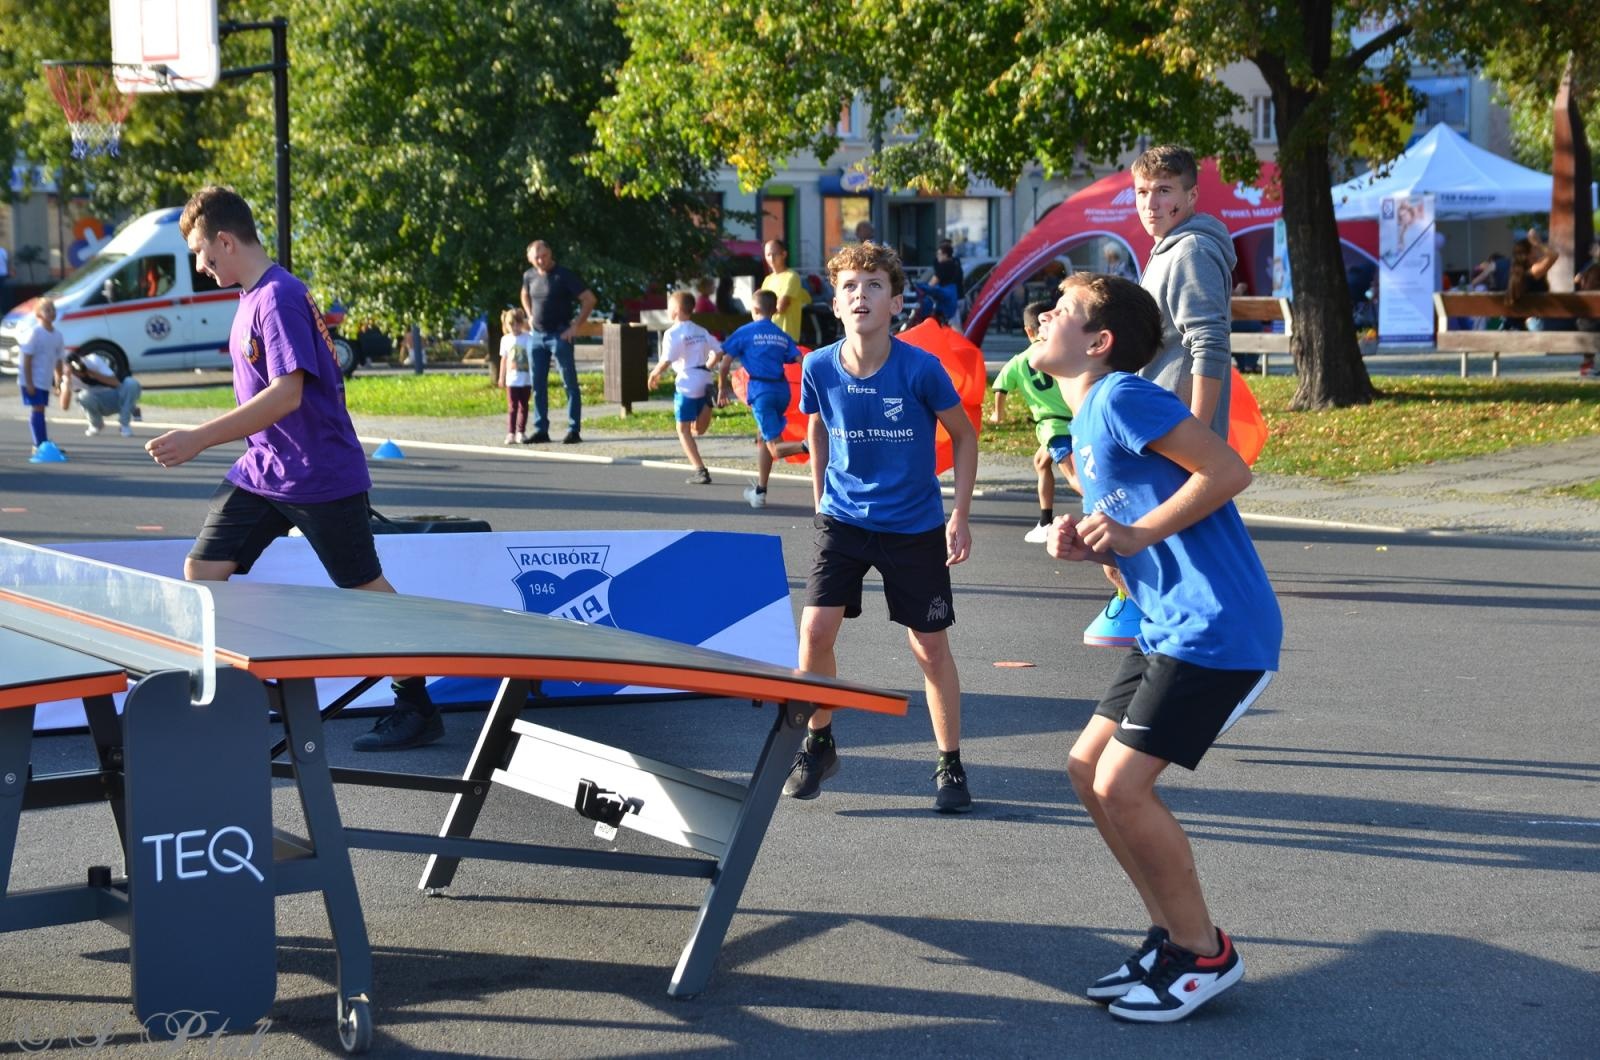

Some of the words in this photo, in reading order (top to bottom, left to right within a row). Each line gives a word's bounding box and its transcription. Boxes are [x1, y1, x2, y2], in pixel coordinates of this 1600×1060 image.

[866, 428, 914, 439] TRENING
[520, 548, 601, 566] RACIBÓRZ
[529, 582, 556, 595] 1946
[142, 825, 265, 882] TEQ
